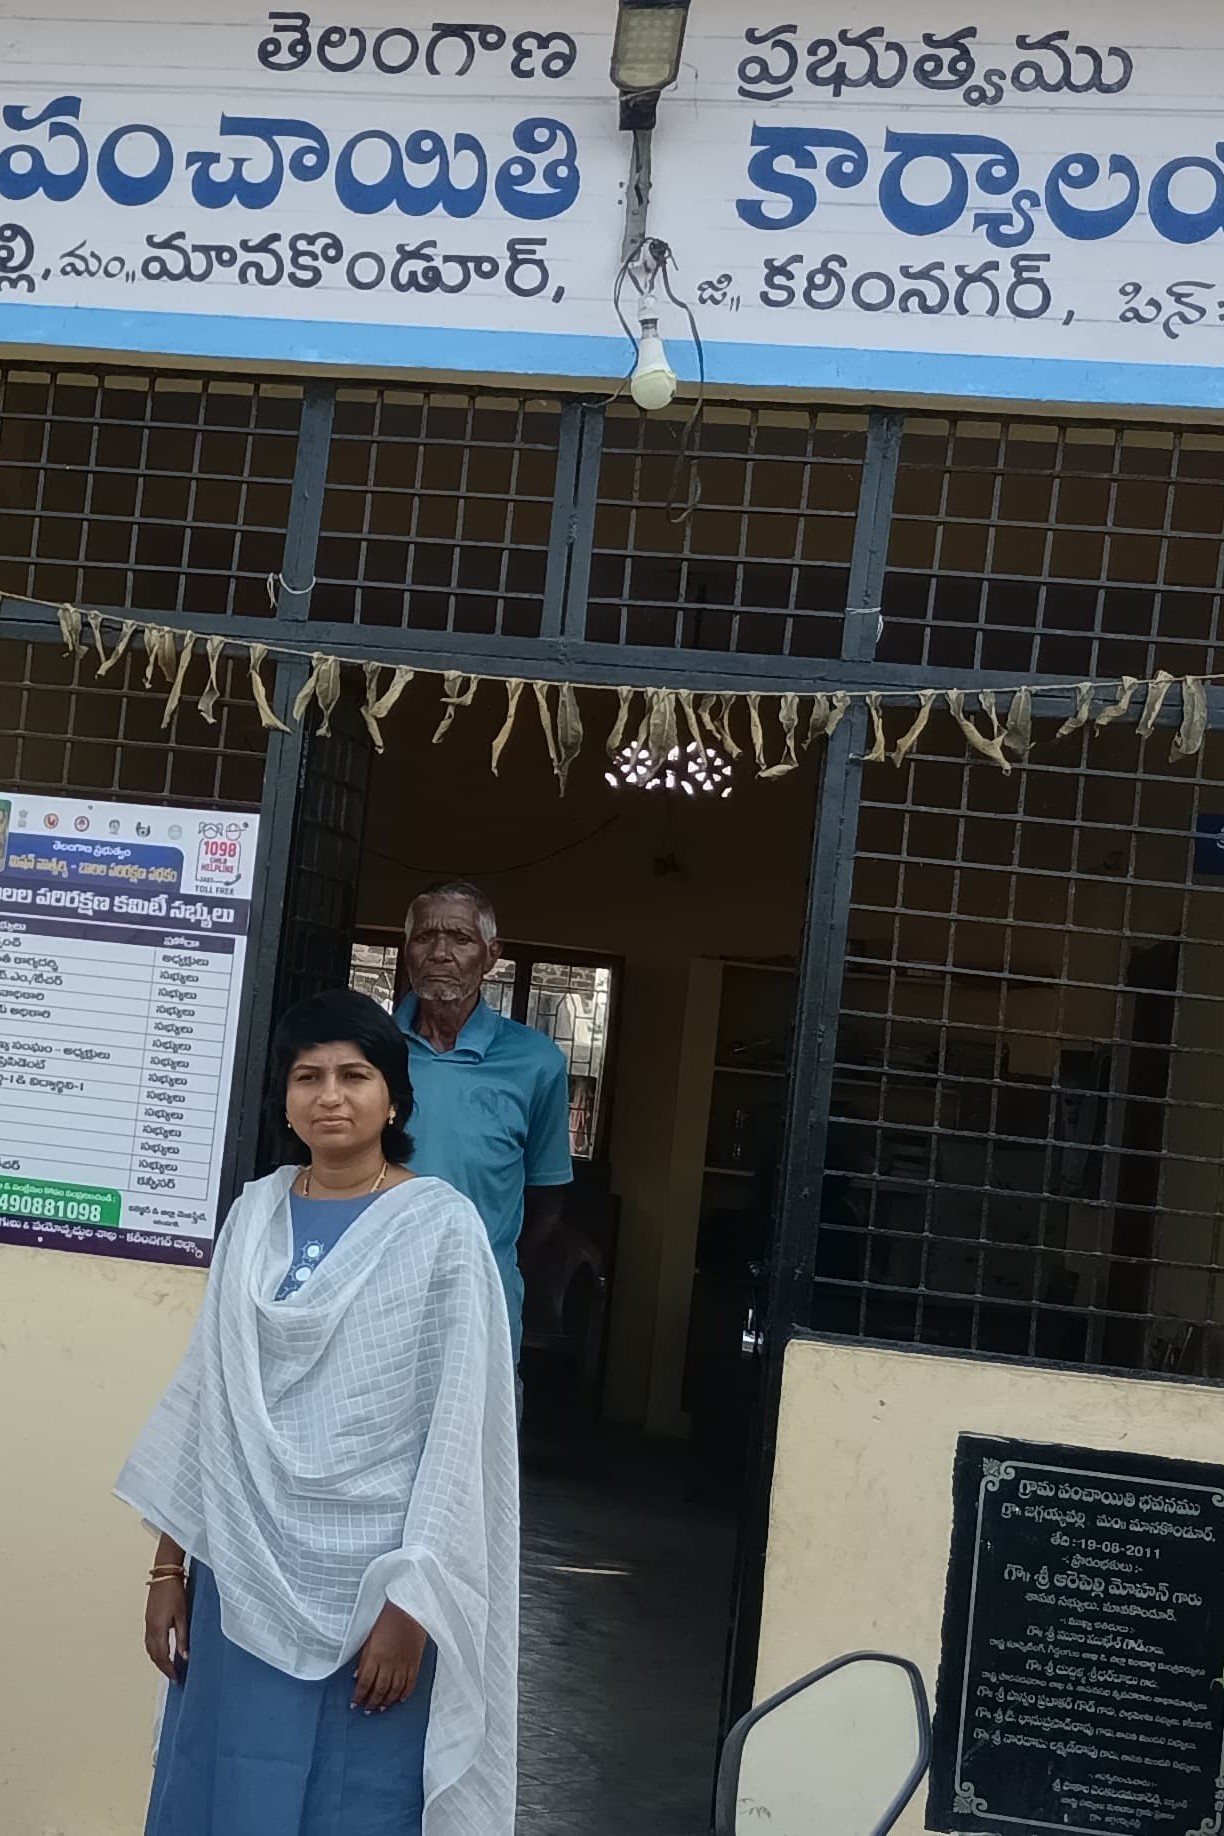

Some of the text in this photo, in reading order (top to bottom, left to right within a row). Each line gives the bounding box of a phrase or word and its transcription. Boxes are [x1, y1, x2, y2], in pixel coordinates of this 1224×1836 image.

[257, 11, 1134, 108] తెలంగాణ ప్రభుత్వము
[204, 841, 237, 858] 1098
[36, 888, 110, 916] పరిరక్షణ
[170, 901, 234, 928] సభ్యులు
[1018, 1480, 1055, 1499] గ్రామ
[1138, 1495, 1200, 1516] భవనము
